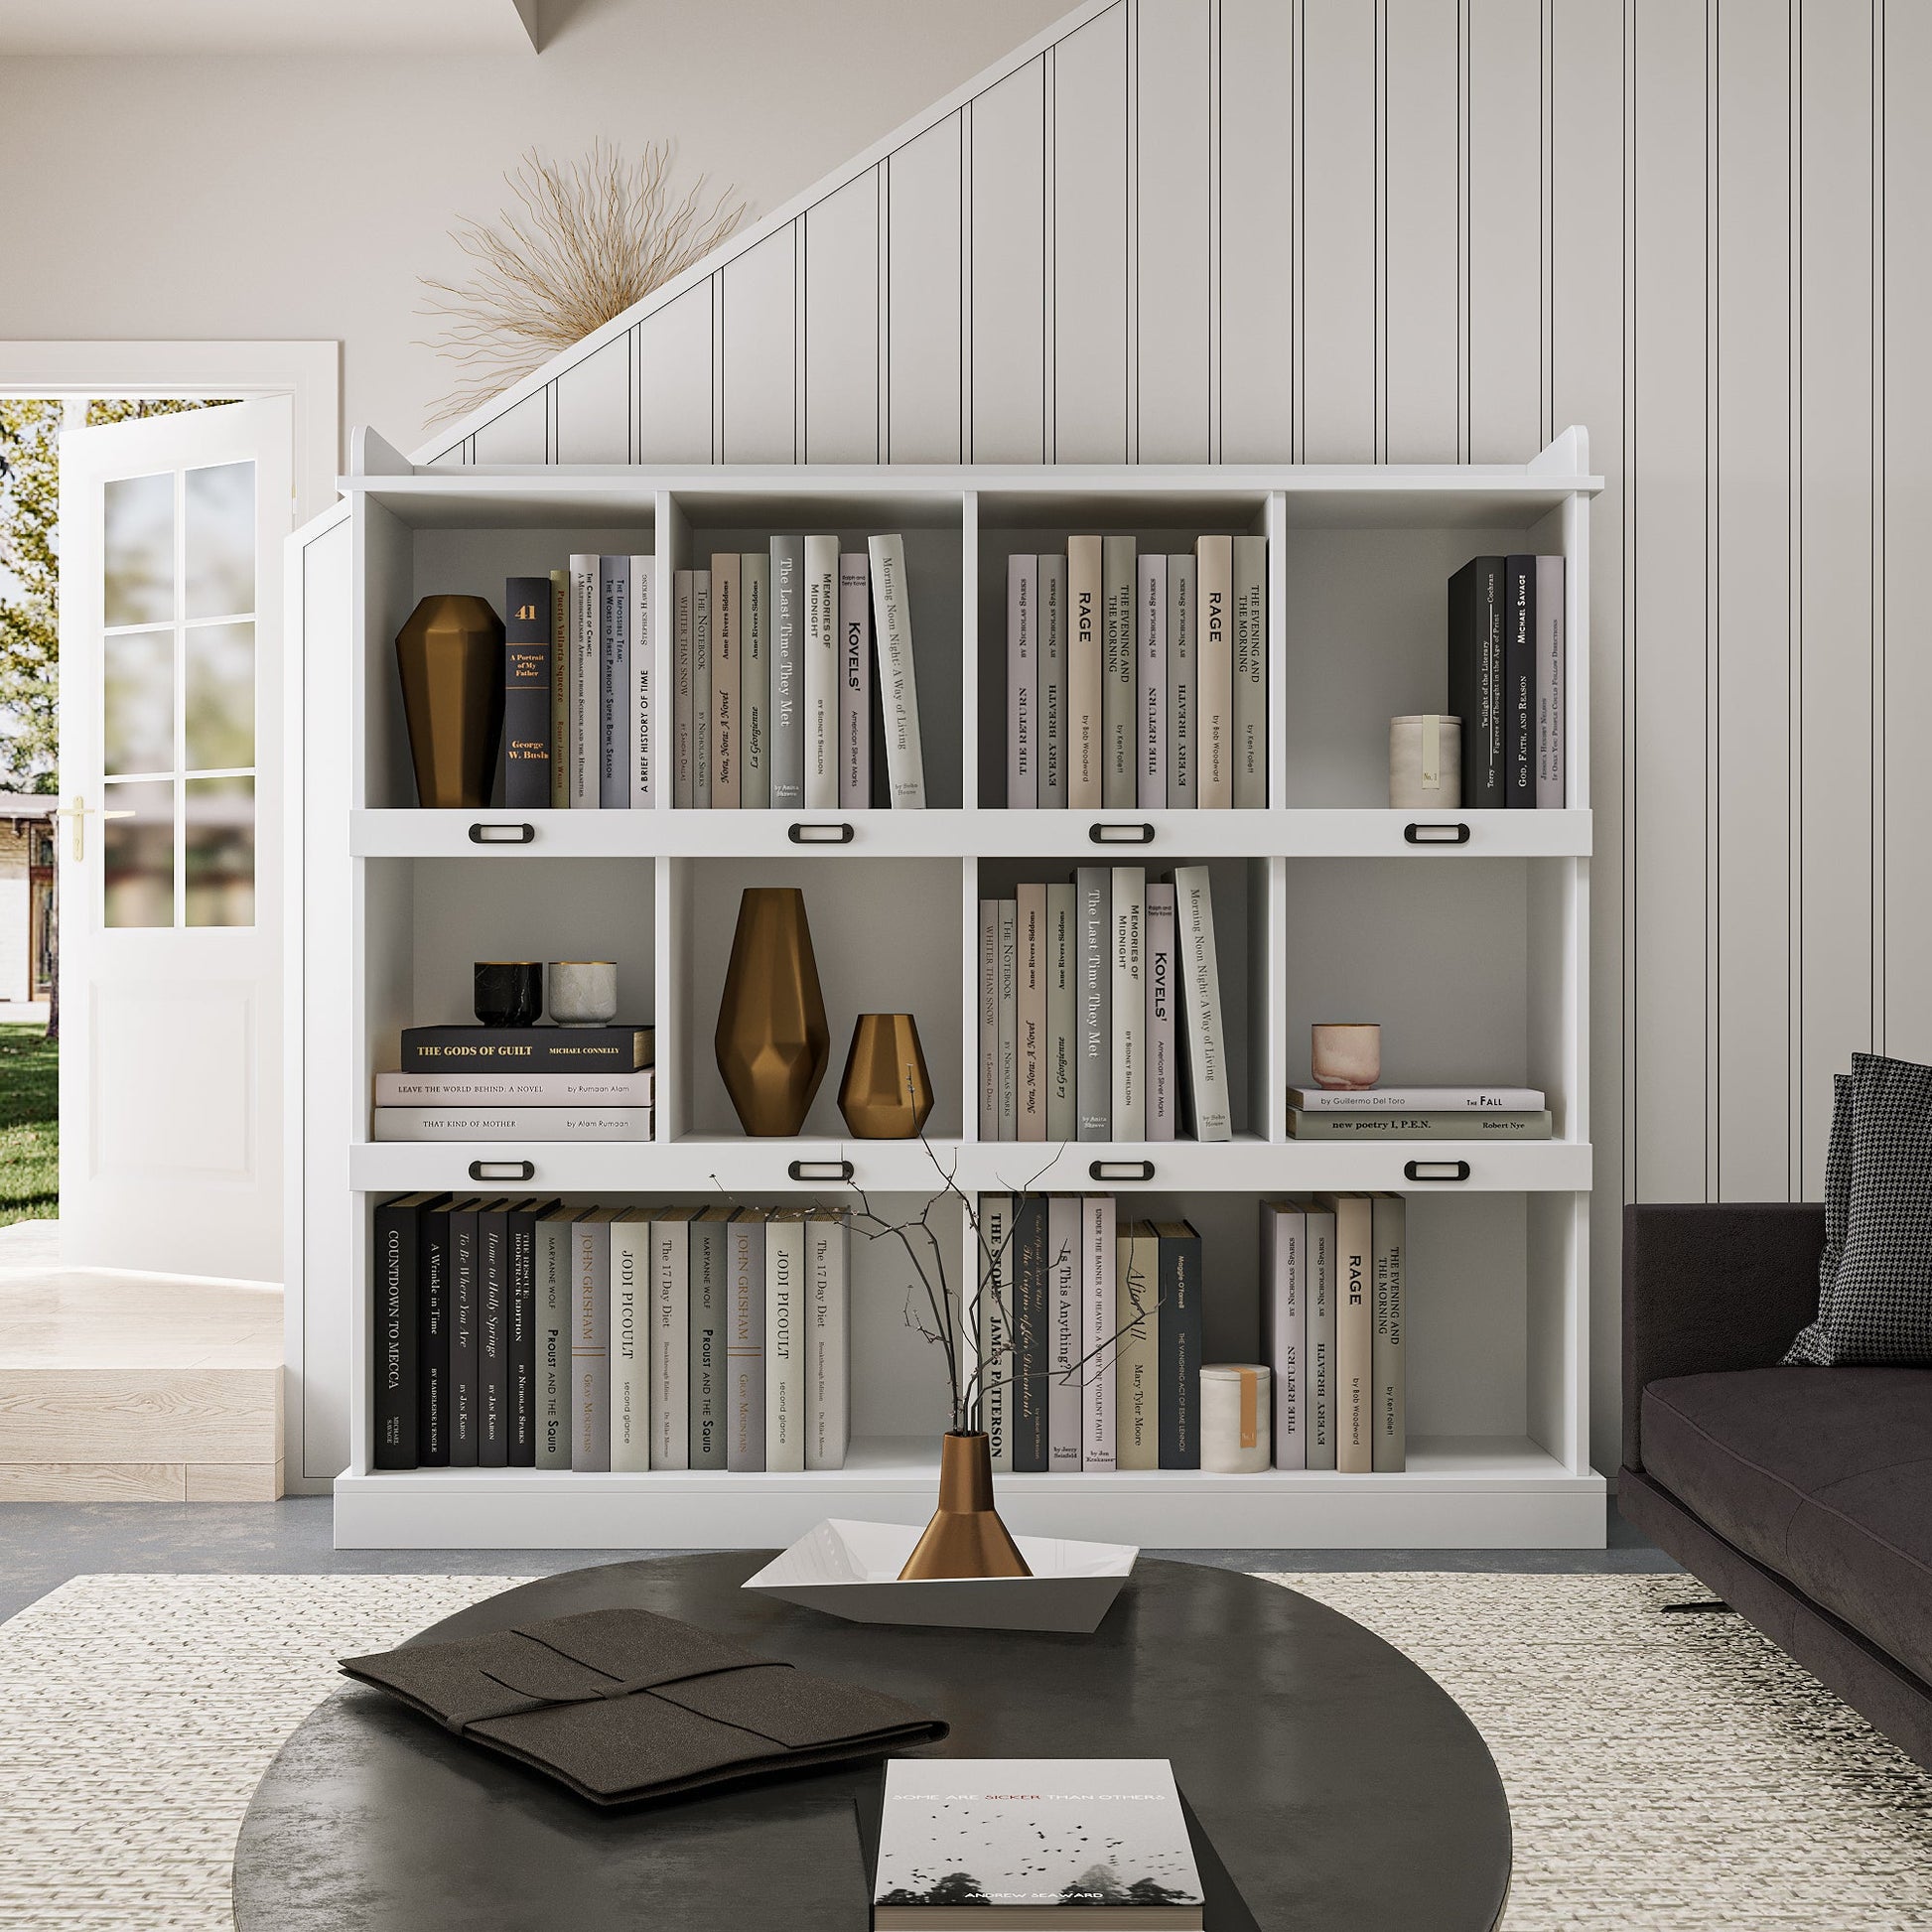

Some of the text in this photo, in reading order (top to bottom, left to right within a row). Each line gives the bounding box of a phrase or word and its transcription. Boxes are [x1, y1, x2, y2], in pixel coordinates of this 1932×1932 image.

[884, 557, 894, 601] Morning
[514, 605, 536, 621] 41
[887, 605, 897, 629] Noon
[1079, 592, 1091, 642] RAGE
[1210, 592, 1221, 642] RAGE
[778, 558, 792, 727] The Last Time They Met
[888, 633, 900, 666] Night:
[1108, 596, 1117, 672] THE MORNING
[1120, 585, 1129, 683] THE EVENING AND
[640, 696, 648, 709] OF
[719, 690, 729, 719] Novel
[892, 679, 903, 701] Way
[896, 704, 905, 714] of
[721, 720, 730, 730] A
[897, 717, 907, 750] Living
[1081, 715, 1089, 725] by
[512, 741, 544, 750] George
[524, 751, 549, 759] Bush
[721, 759, 730, 783] Nora,
[417, 1046, 532, 1056] THE GODS OF GUILT
[568, 1085, 576, 1094] by
[567, 1120, 576, 1129] by
[1356, 1121, 1388, 1131] poetry
[1391, 1121, 1398, 1130] I,
[431, 1243, 440, 1334] A Wrinkle in Time
[460, 1233, 470, 1347] To Be Where You Are
[486, 1232, 497, 1358] Home to Holly Springs
[580, 1234, 593, 1340] JOHN GRISHAM
[815, 1240, 827, 1327] The 17 Day Diet
[1349, 1255, 1361, 1305] RAGE
[388, 1230, 399, 1389] COUNTDOWN TO MECCA
[621, 1250, 633, 1359] JODI PICOULT
[1057, 1249, 1072, 1370] Is This Anything?
[547, 1329, 559, 1452] PROUST AND THE SQUID
[1132, 1364, 1144, 1446] Mary Tyler Moore
